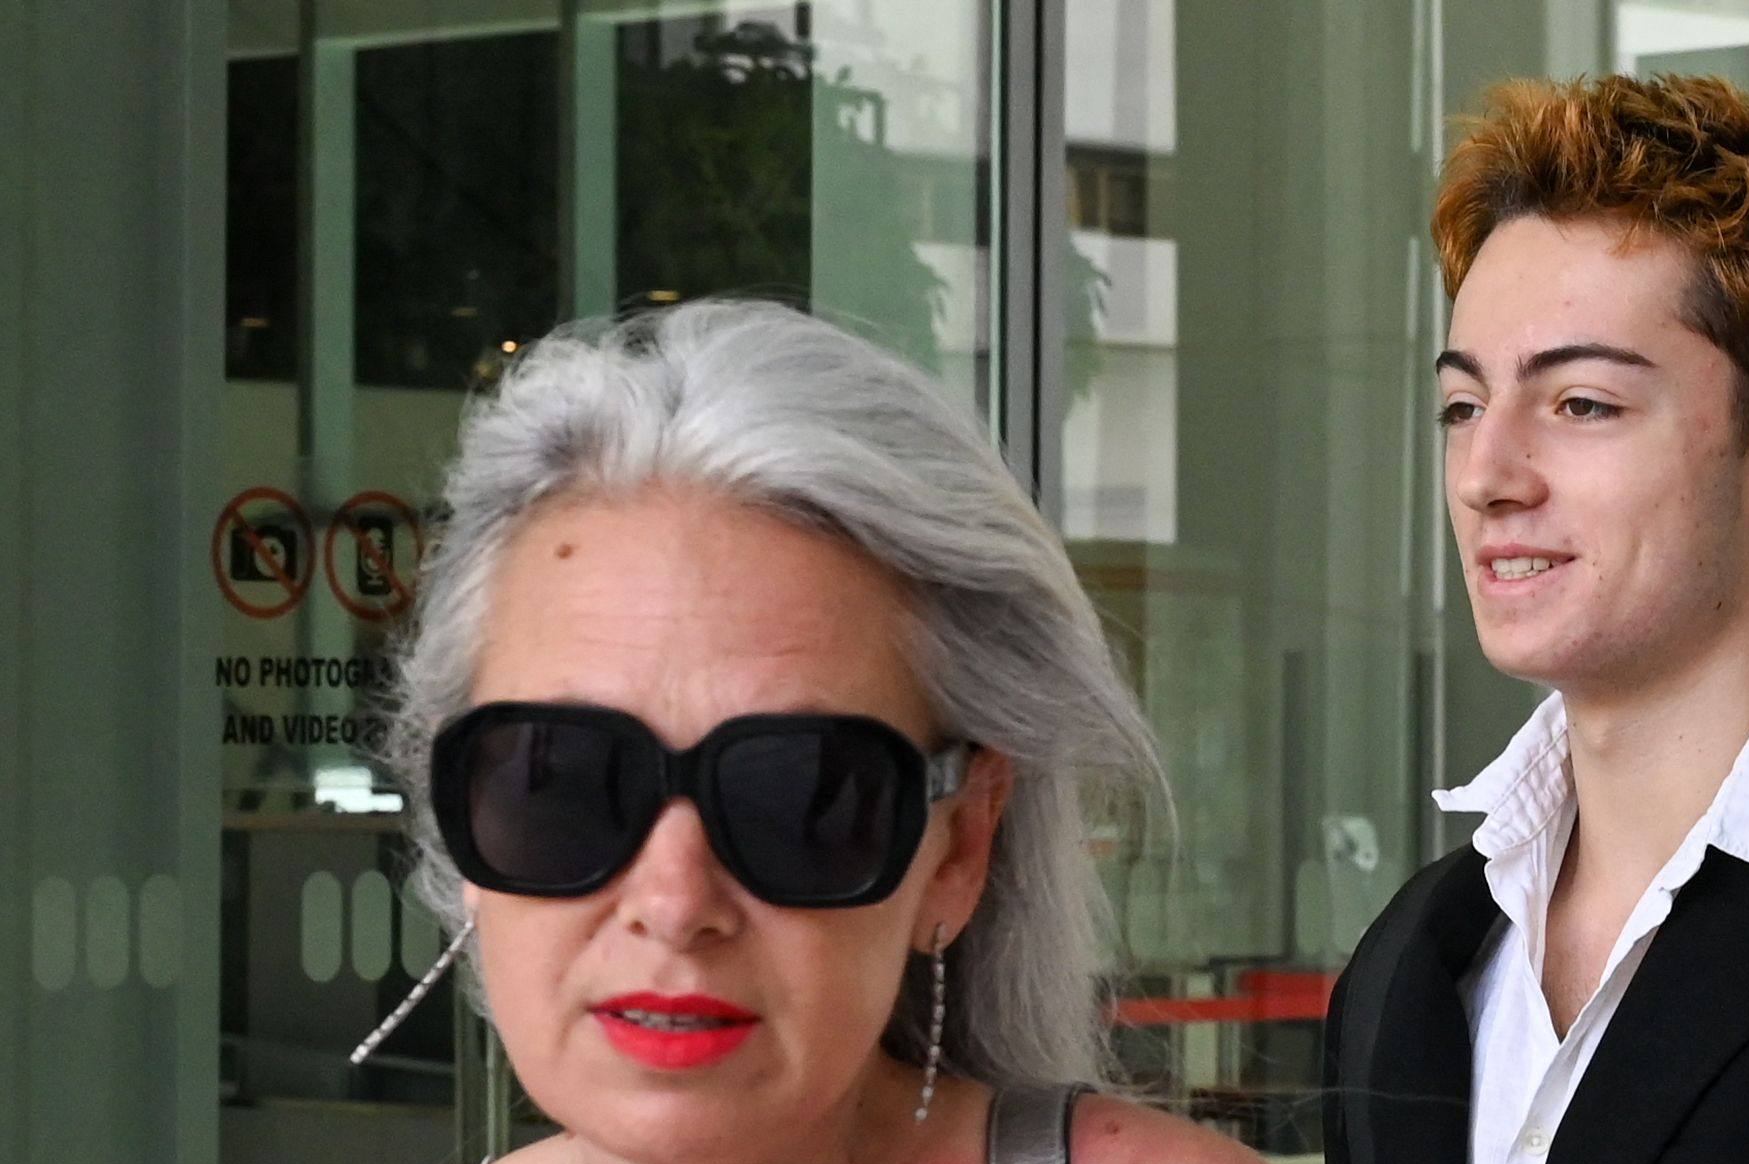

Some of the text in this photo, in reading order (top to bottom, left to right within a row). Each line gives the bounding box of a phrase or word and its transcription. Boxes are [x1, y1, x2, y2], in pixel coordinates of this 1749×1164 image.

[215, 656, 251, 688] NO
[222, 714, 275, 745] AND
[282, 714, 358, 745] VIDEO
